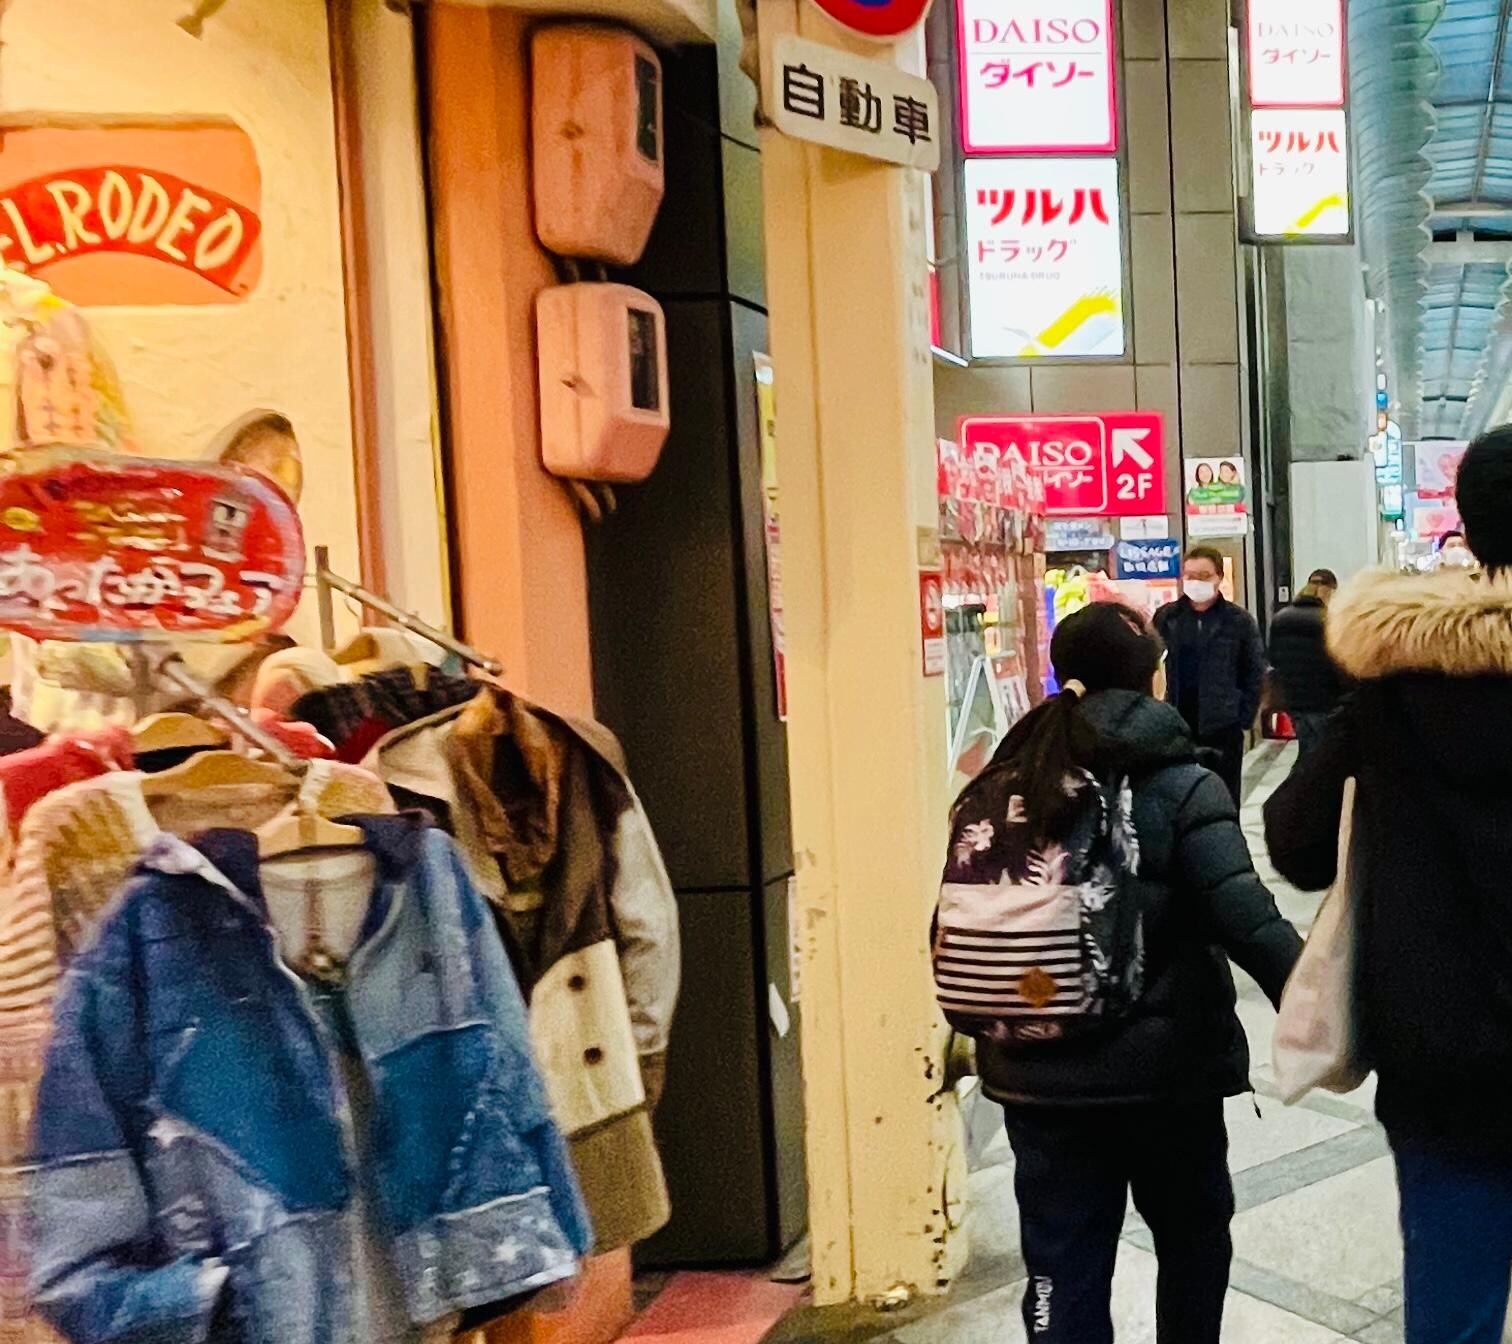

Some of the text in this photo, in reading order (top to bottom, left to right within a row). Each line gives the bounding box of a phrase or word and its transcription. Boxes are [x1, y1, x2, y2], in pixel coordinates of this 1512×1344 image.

[973, 18, 1101, 44] DAISO
[980, 59, 1096, 89] ダイソー
[783, 63, 932, 145] 自動車
[1258, 131, 1340, 154] ツルハ
[976, 188, 1110, 226] ツルハ
[977, 238, 1077, 264] ドラッグ
[1116, 472, 1153, 500] 2F
